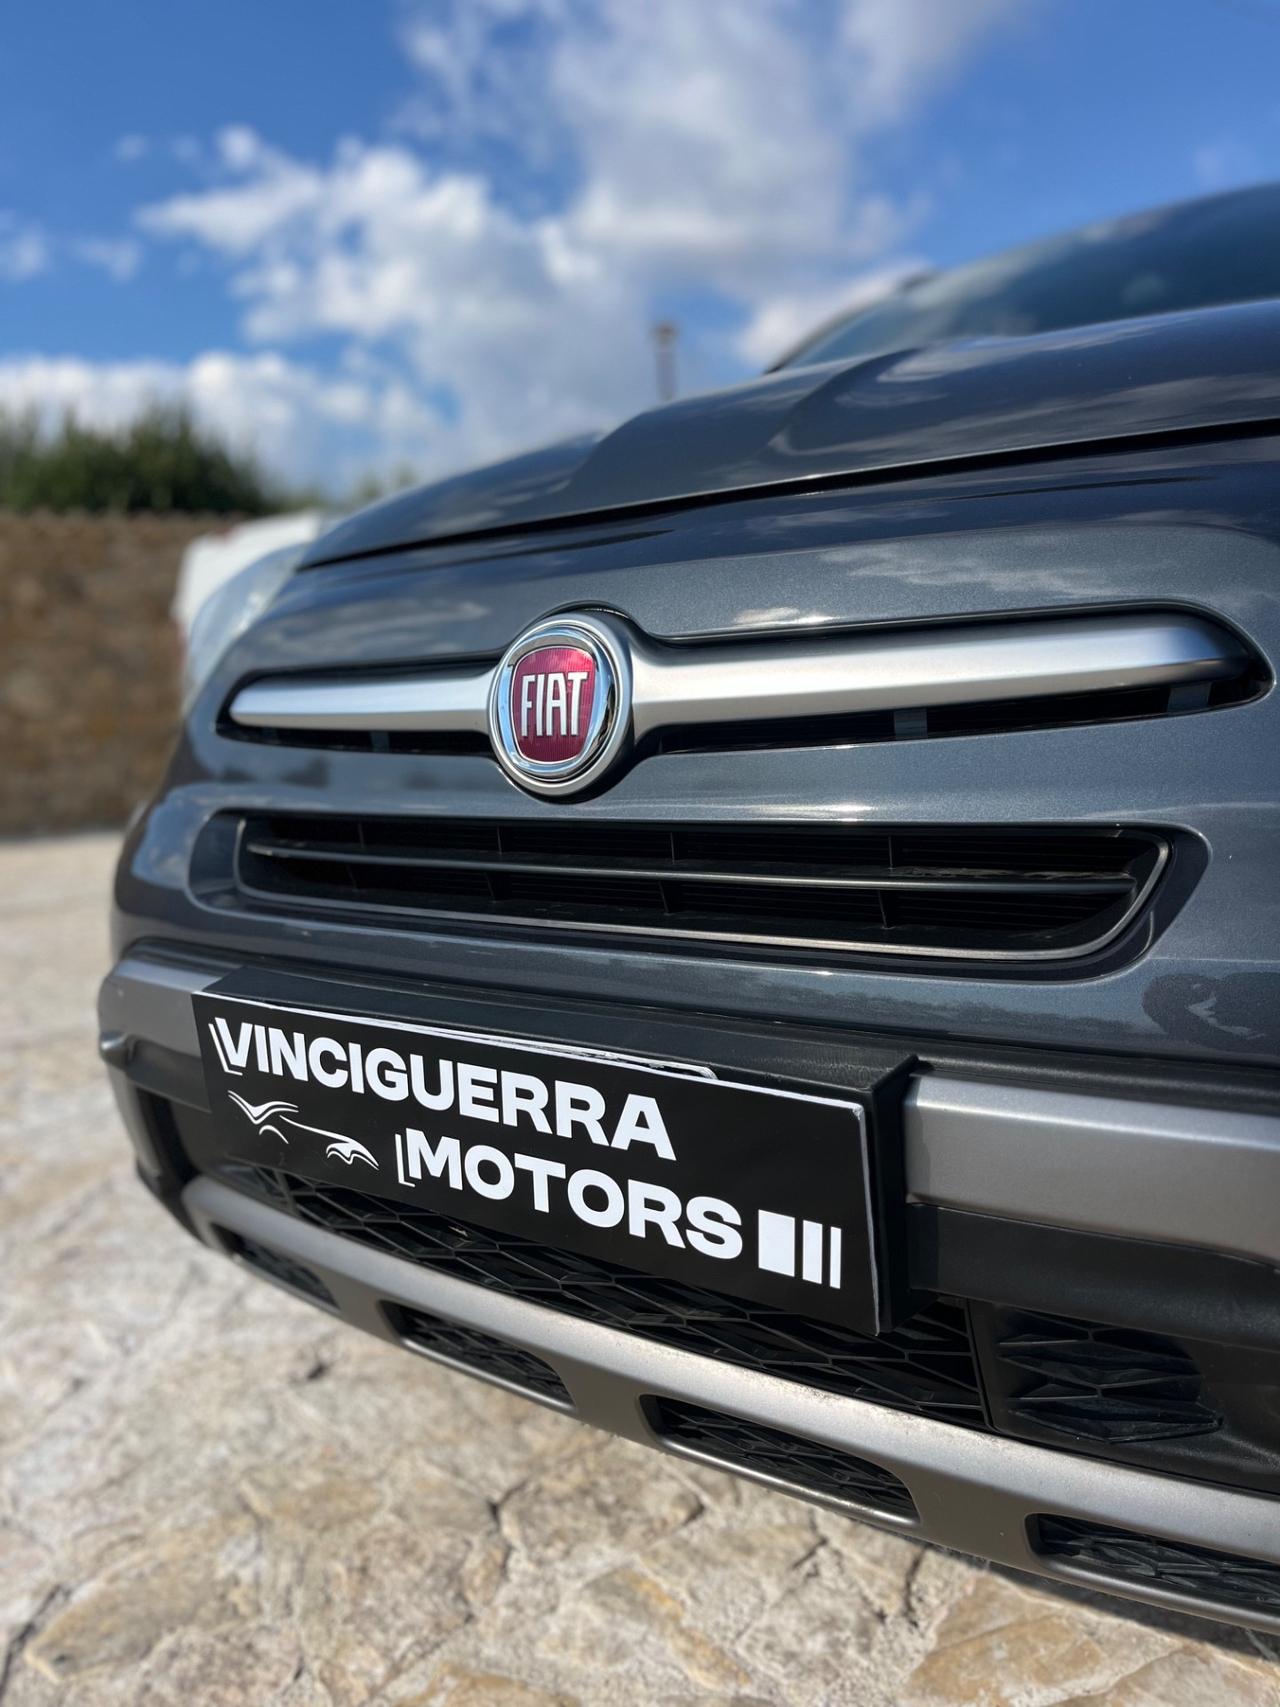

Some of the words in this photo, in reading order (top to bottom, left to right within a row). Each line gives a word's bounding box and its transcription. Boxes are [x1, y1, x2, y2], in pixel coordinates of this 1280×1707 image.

[520, 671, 588, 737] FIAT
[213, 1016, 677, 1161] VINCIGUERRA
[404, 1129, 743, 1260] MOTORS
